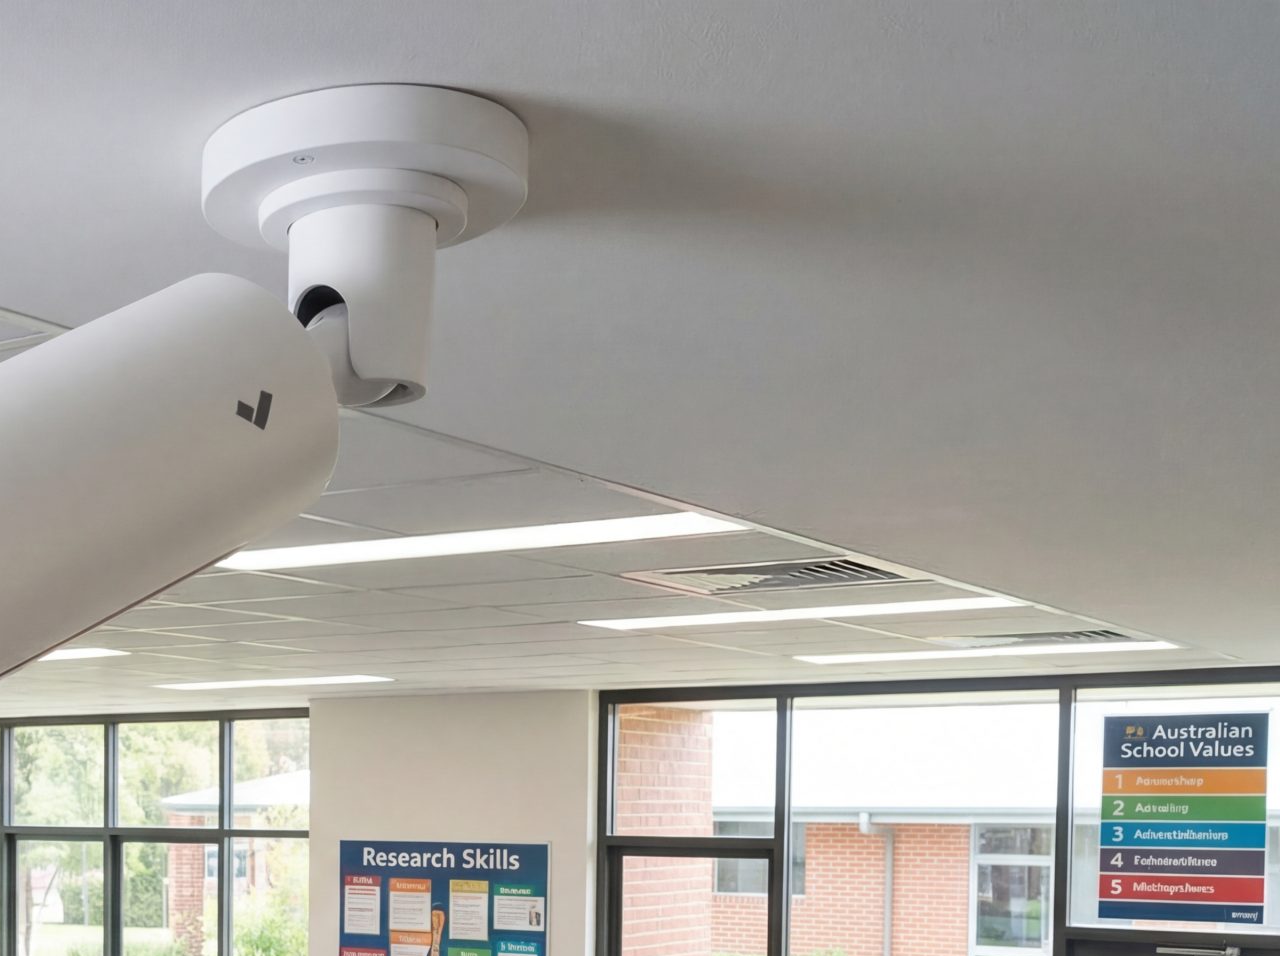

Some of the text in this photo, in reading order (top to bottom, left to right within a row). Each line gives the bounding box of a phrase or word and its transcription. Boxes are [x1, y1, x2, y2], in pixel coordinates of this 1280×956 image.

[1152, 723, 1253, 740] Australian
[1121, 741, 1255, 759] School Values
[1114, 773, 1124, 790] 1
[1112, 800, 1125, 816] 2
[1111, 825, 1124, 842] 3
[362, 847, 521, 870] Research Skills
[1110, 853, 1124, 869] 4
[1110, 879, 1123, 895] 5
